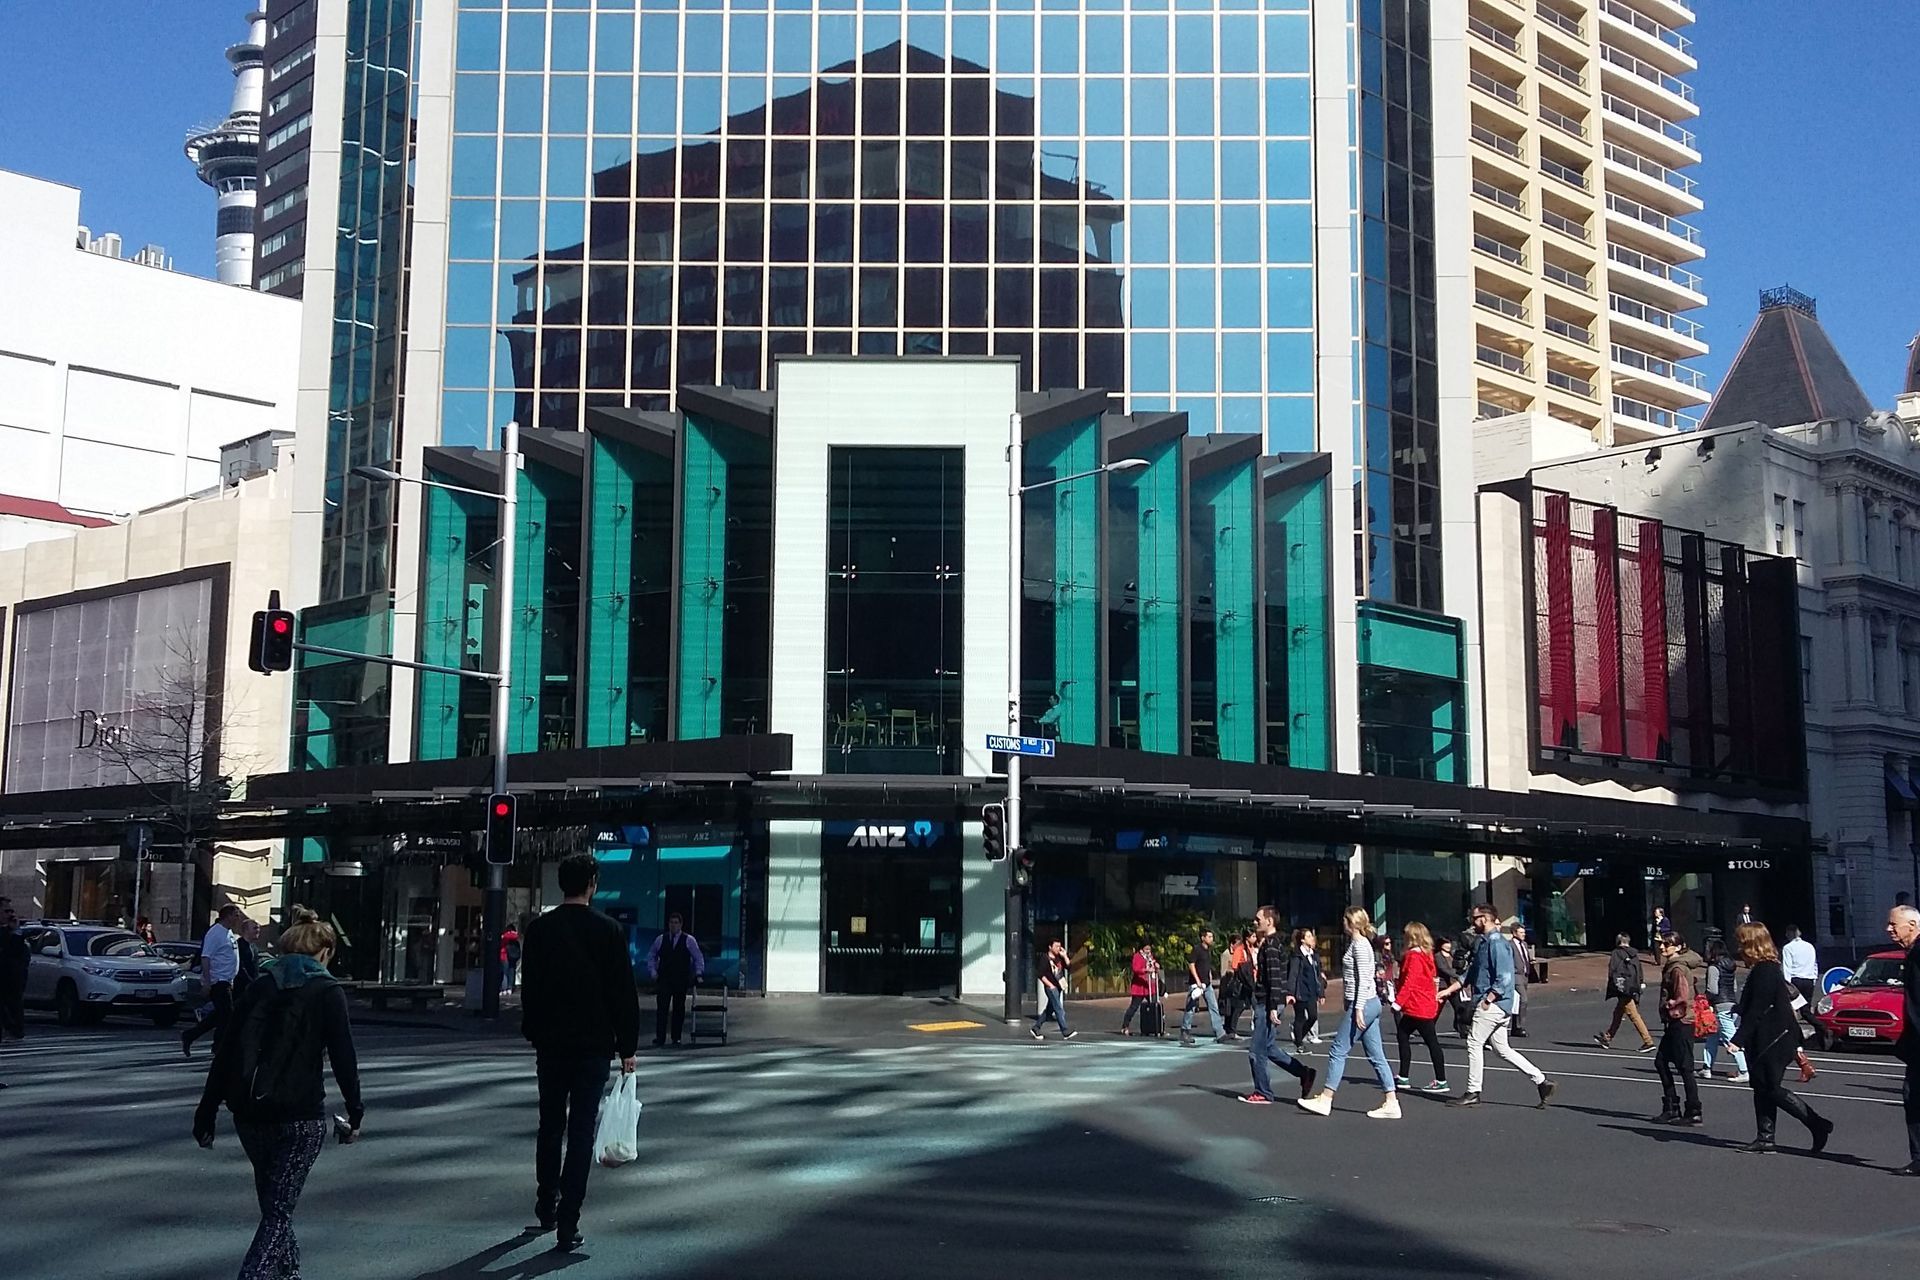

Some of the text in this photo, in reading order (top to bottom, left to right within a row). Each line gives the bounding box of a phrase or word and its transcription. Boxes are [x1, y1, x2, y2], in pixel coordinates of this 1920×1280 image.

[75, 709, 128, 749] Dior
[988, 735, 1021, 751] CUSTOMS
[597, 831, 615, 842] ANZ
[846, 825, 907, 848] ANZ
[1142, 838, 1160, 848] ANZ
[138, 848, 165, 861] Dior
[1735, 859, 1770, 870] TOUS
